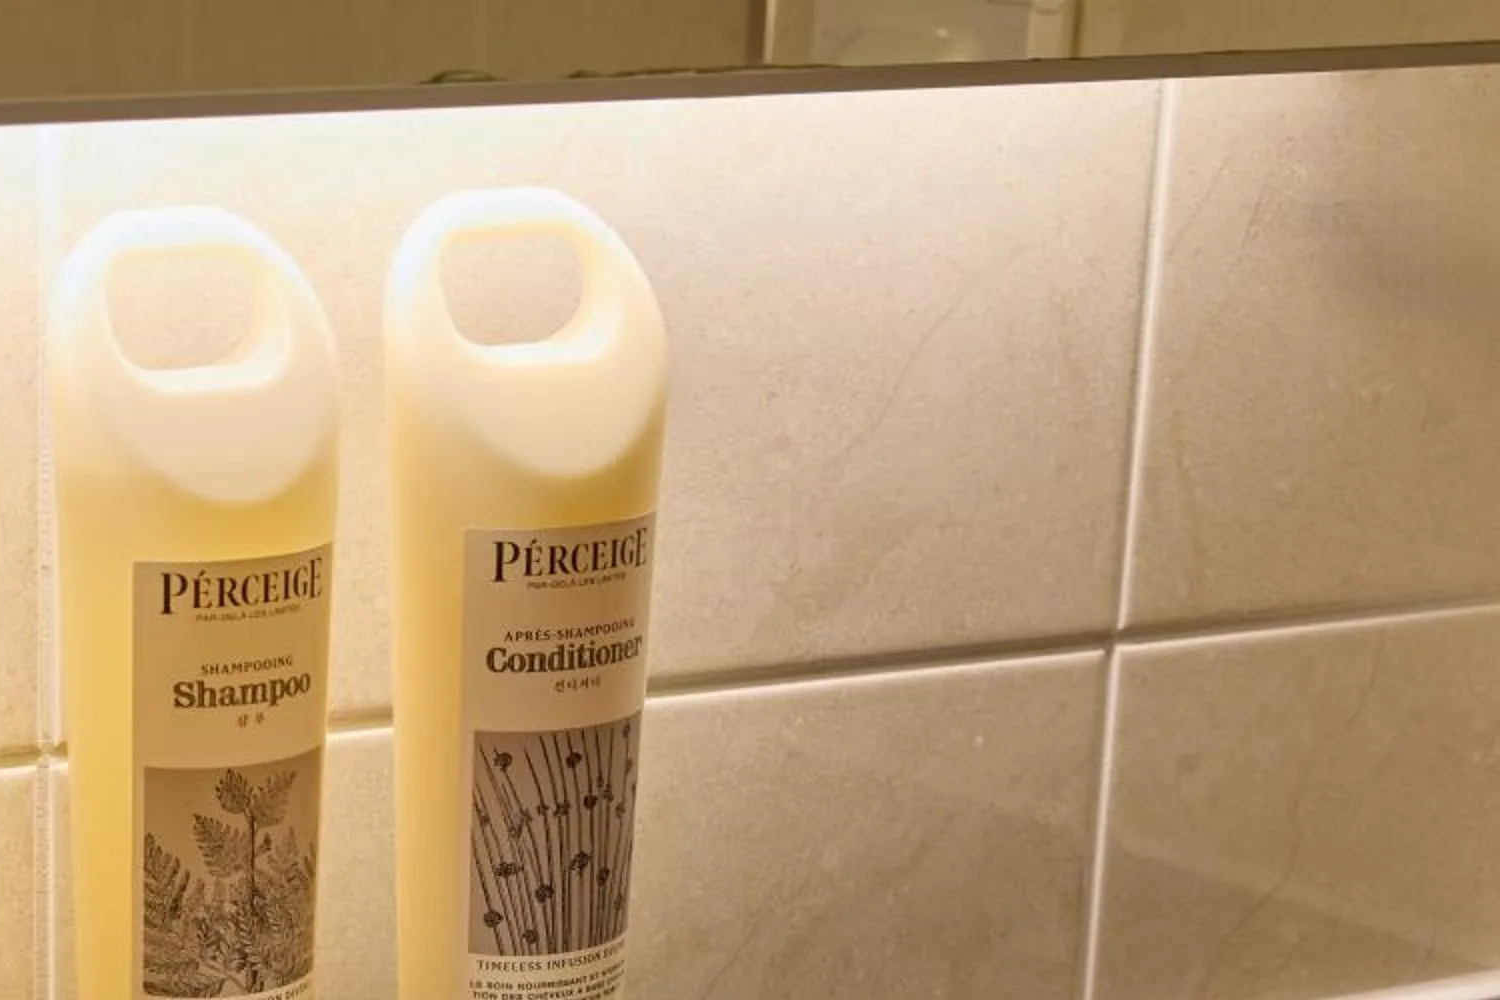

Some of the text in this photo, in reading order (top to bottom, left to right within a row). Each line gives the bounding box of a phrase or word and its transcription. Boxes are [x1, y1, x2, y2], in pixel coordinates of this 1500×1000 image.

[490, 528, 648, 582] PÉRCEIGE
[160, 557, 322, 615] PÉRCEIGE
[485, 633, 643, 674] Conditioner
[172, 673, 311, 709] Shampoo
[476, 959, 542, 973] TIMELESS
